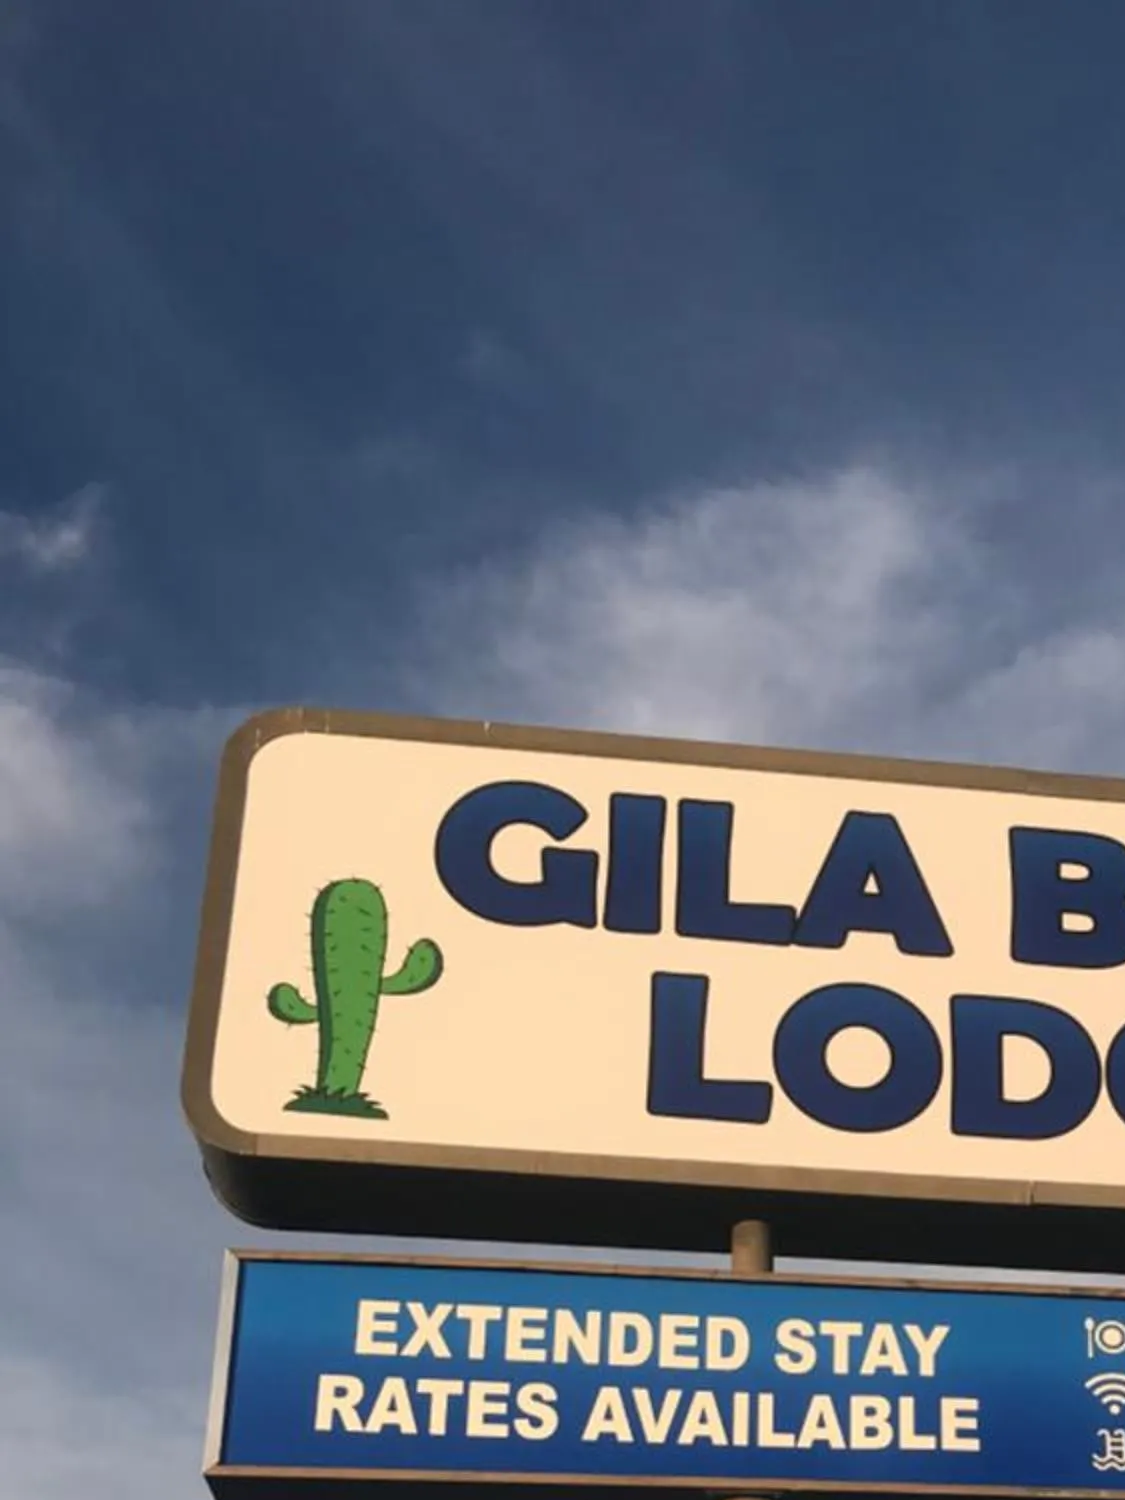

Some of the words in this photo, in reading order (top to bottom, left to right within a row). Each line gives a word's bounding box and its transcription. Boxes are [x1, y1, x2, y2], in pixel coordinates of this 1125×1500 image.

[436, 782, 953, 957] GILA
[354, 1299, 751, 1372] EXTENDED
[774, 1318, 950, 1377] STAY
[314, 1373, 560, 1440] RATES
[581, 1385, 981, 1452] AVAILABLE
